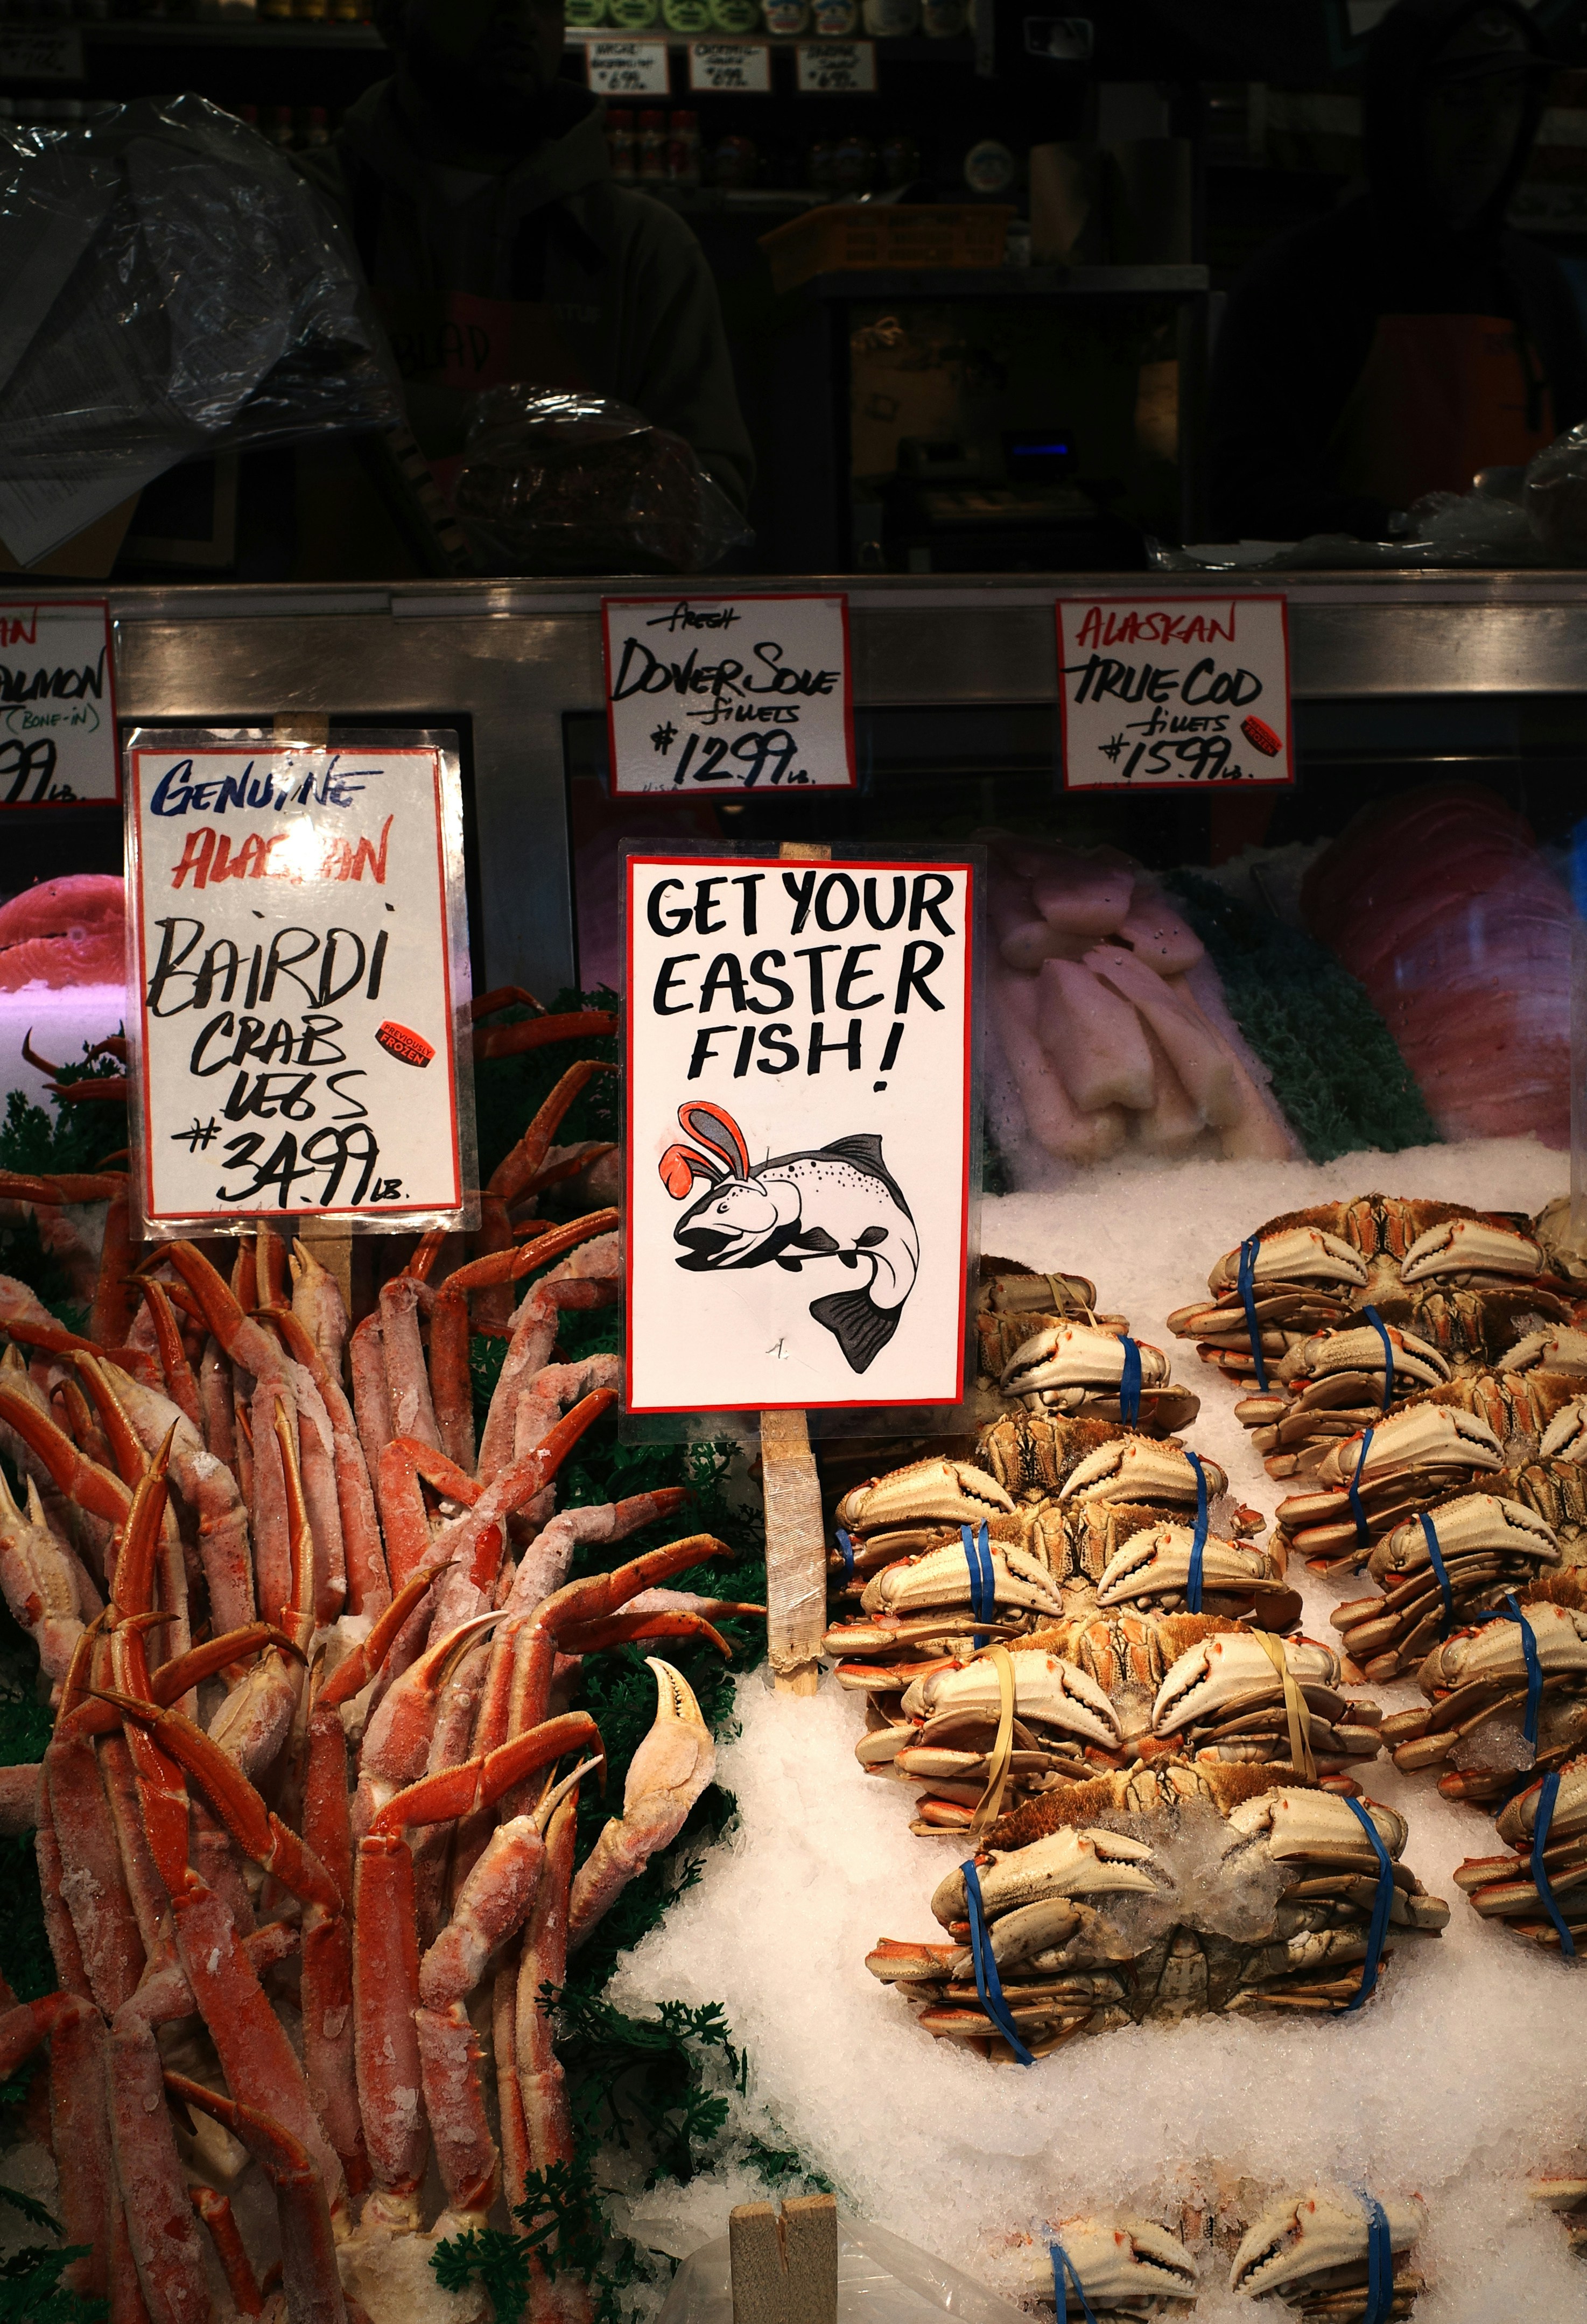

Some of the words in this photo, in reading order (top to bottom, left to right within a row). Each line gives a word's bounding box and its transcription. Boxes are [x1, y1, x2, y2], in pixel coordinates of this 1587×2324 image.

[1076, 601, 1235, 649] ALASKAN
[609, 637, 746, 701] DOVER
[743, 642, 841, 695] SOLE
[1061, 653, 1179, 704] TRUE
[1181, 657, 1262, 707] COD
[1244, 725, 1274, 753] FROZEN
[150, 755, 385, 816] GENUINE
[172, 814, 394, 889] ALASAN
[647, 873, 766, 937] GET
[782, 870, 956, 938] YOUR
[653, 940, 946, 1016] EASTER
[189, 1011, 347, 1077] CRAB
[380, 1033, 424, 1065] FROZEN
[384, 1024, 432, 1057] PREVIOUSLY
[687, 1018, 905, 1093] FISH!
[220, 1069, 369, 1121] LEGS
